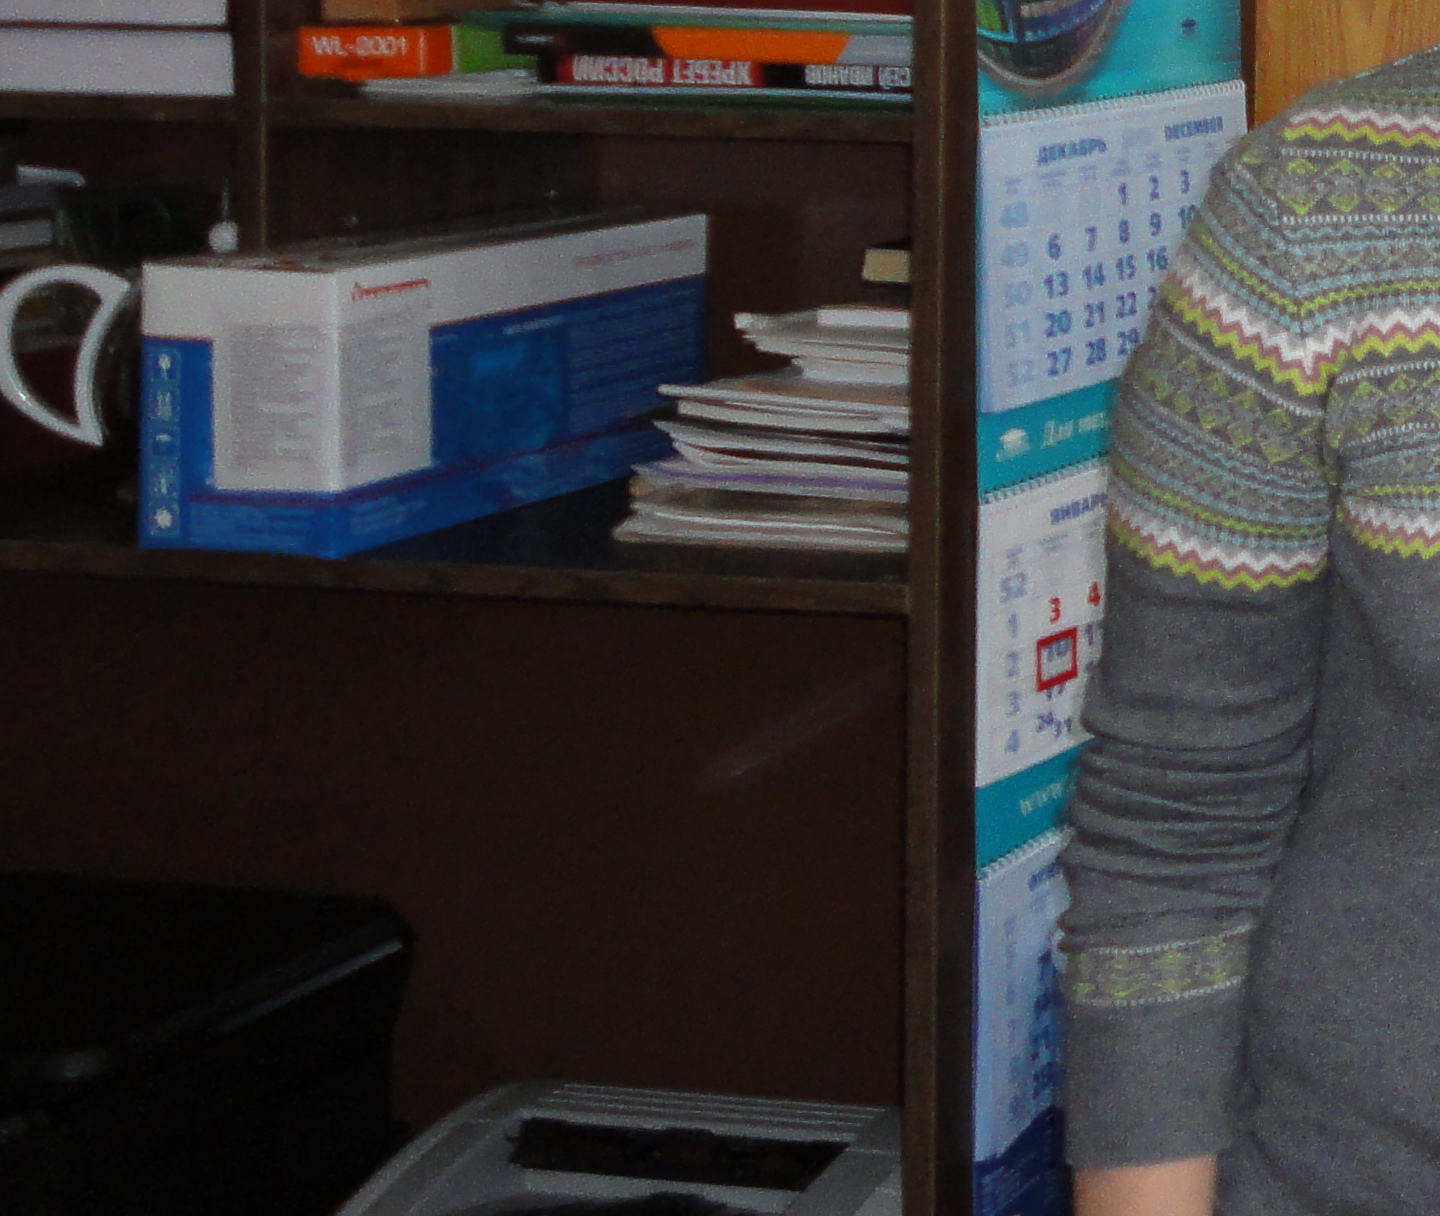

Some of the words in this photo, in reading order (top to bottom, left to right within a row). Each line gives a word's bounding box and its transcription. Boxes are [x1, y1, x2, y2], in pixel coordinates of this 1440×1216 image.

[1038, 138, 1107, 167] ДЕКАБРЬ
[1118, 182, 1128, 206] 1
[1149, 175, 1160, 201] 2
[1180, 169, 1191, 194] 3
[1048, 233, 1061, 261] 6
[1085, 225, 1098, 252] 7
[1118, 218, 1130, 244] 8
[1149, 211, 1162, 237] 9
[1043, 270, 1069, 299] 13
[1082, 261, 1106, 290] 14
[1115, 254, 1137, 281] 15
[1146, 245, 1169, 273] 16
[1045, 309, 1072, 338] 20
[1083, 301, 1105, 328] 21
[1115, 291, 1138, 319] 22
[1046, 346, 1072, 376] 27
[1085, 337, 1107, 366] 28
[1048, 597, 1061, 624] 3
[1087, 581, 1101, 607] 4
